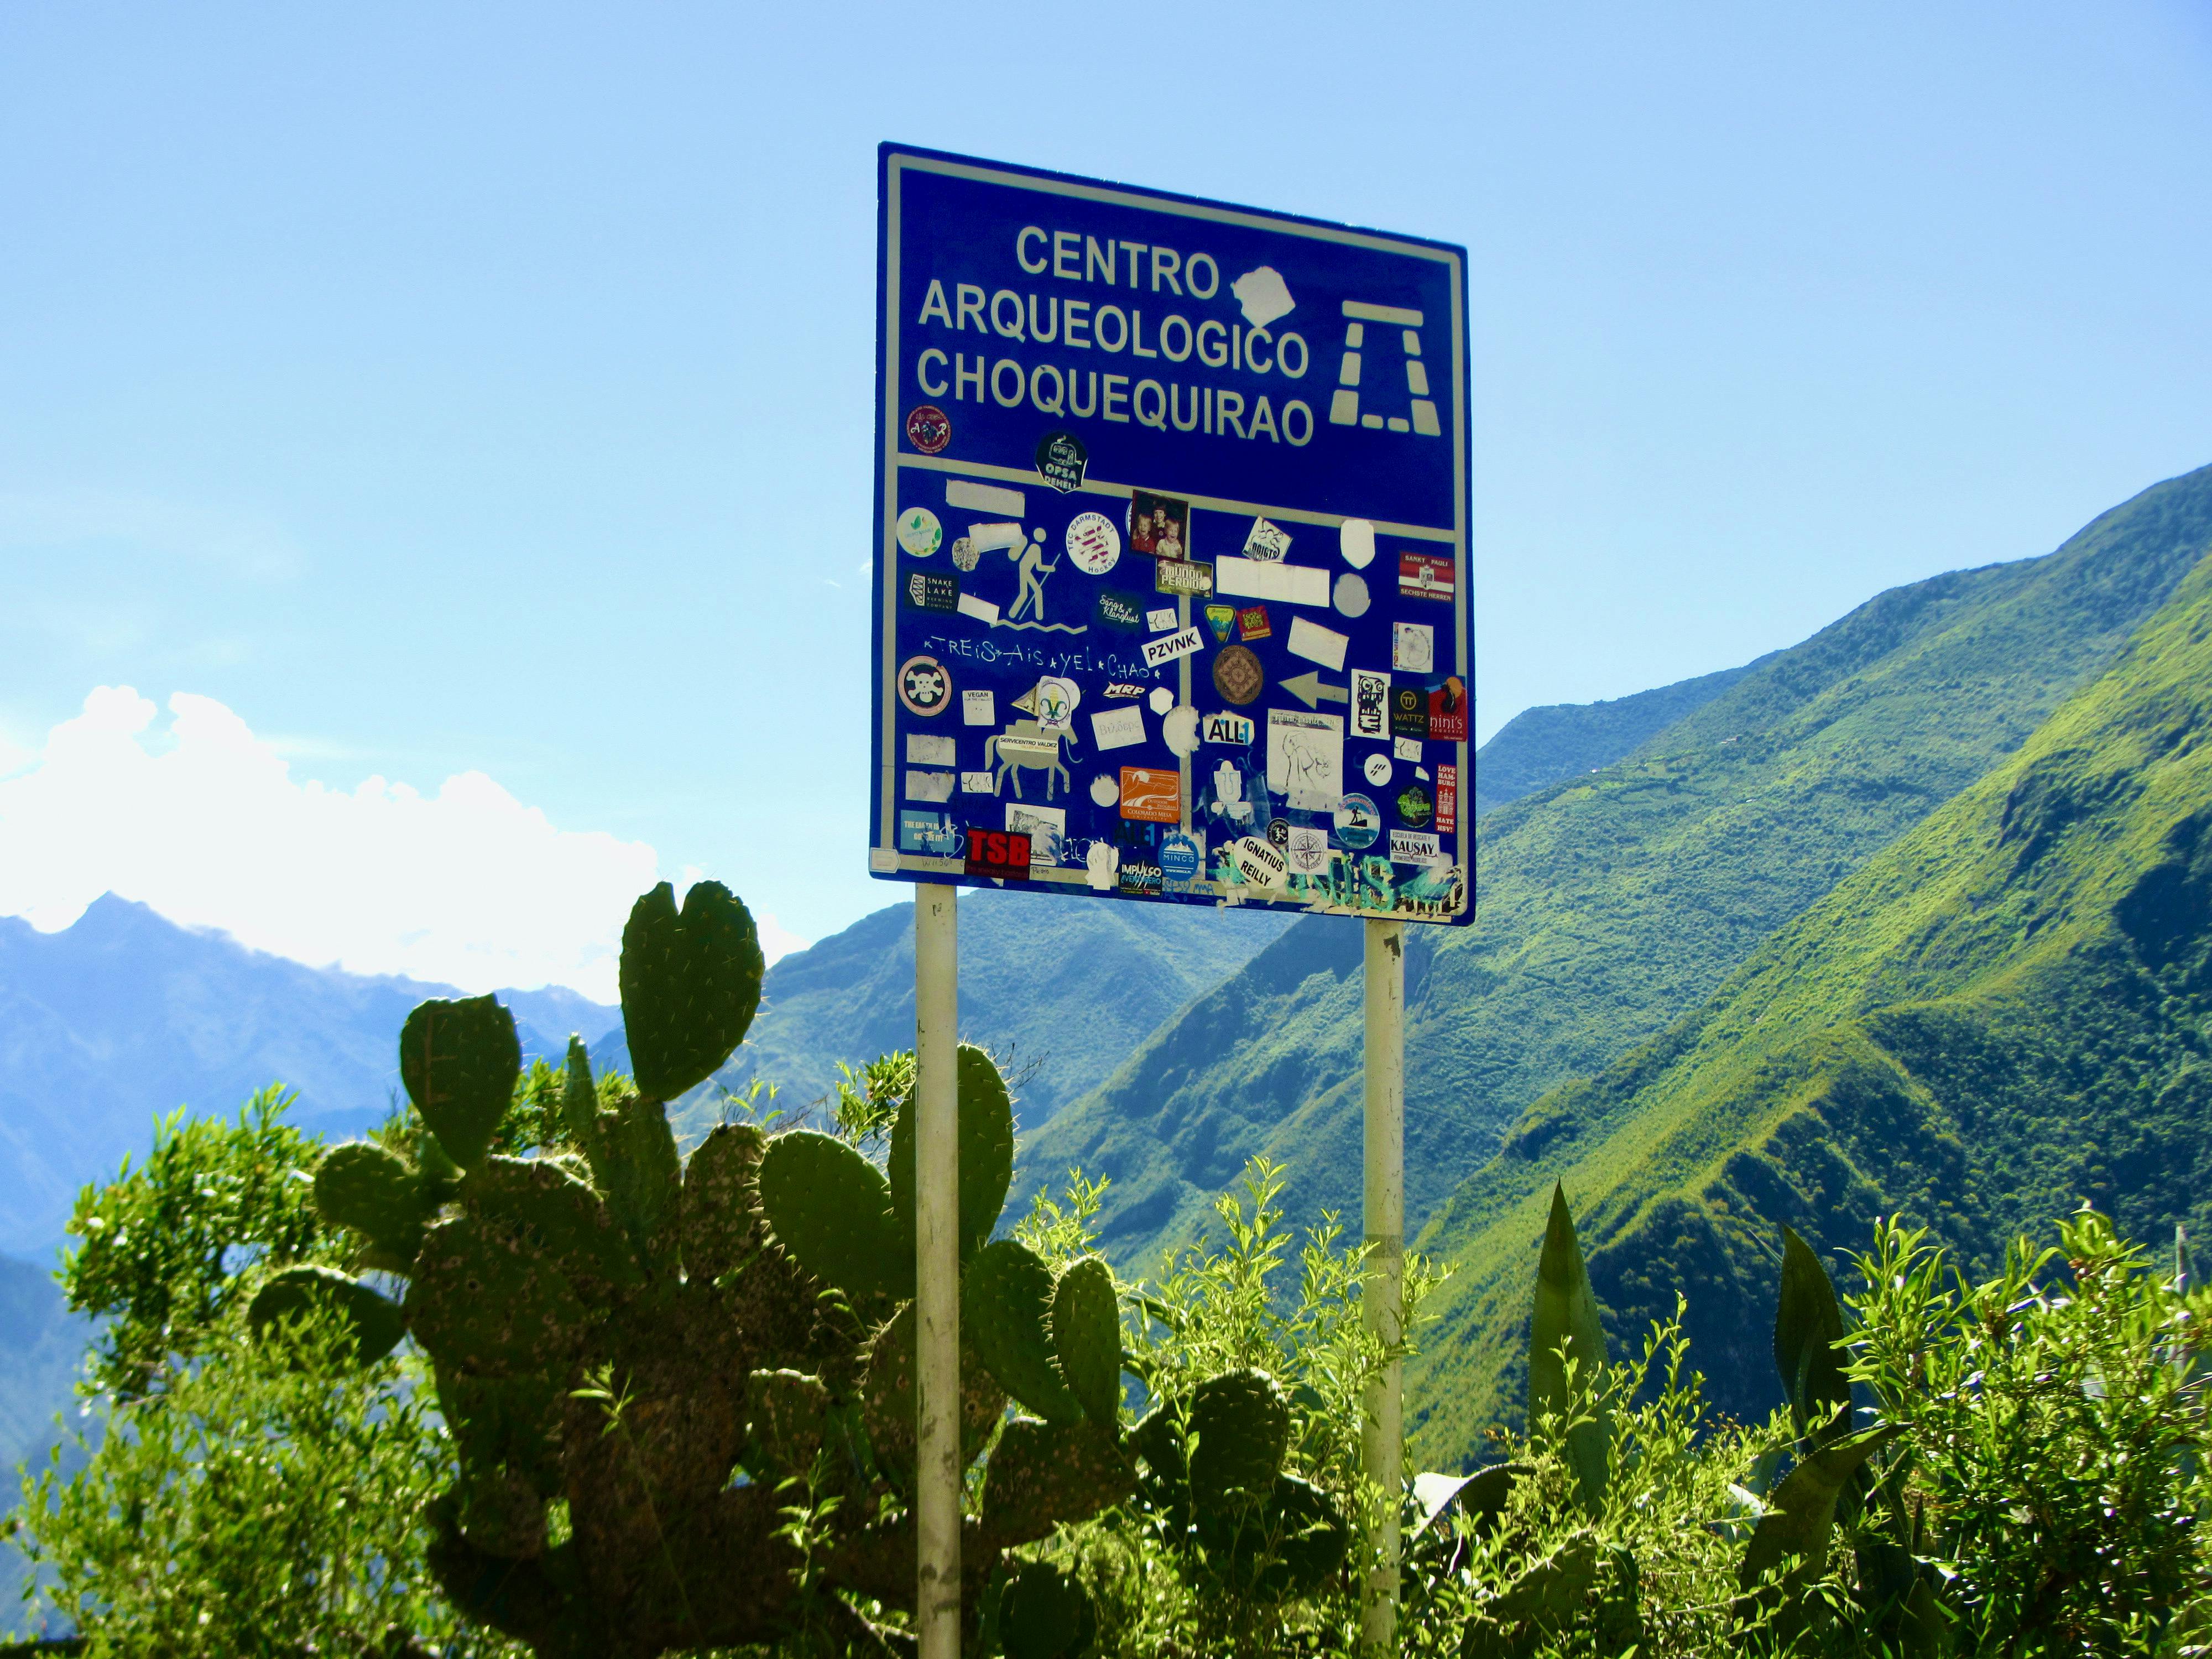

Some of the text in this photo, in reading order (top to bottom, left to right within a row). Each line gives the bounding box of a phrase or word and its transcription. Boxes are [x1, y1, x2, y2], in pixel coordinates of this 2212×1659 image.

[1016, 226, 1219, 300] CENTRO
[918, 279, 1309, 379] ARQUEOLOGICO
[917, 348, 1313, 447] CHOQUEQUIRAO
[1045, 463, 1077, 481] OPSA
[1071, 514, 1114, 533] DARMSTADT
[1088, 557, 1116, 573] Hockey
[927, 578, 952, 588] SNAKE
[1162, 575, 1201, 591] PERDID
[927, 587, 952, 597] LAKE
[1400, 588, 1452, 601] SECHSTE HERREN
[1148, 632, 1197, 661] PZVNK
[1102, 681, 1146, 695] MRP
[1394, 713, 1425, 724] WATTZ
[1430, 714, 1463, 729] nini's
[1000, 737, 1036, 746] SERVICENTRO
[1438, 765, 1455, 774] LOVE
[1438, 772, 1455, 781] HAM-
[1438, 779, 1455, 787] BURG
[1437, 817, 1454, 825] HATE
[1437, 825, 1453, 833] HSV!
[967, 830, 1030, 867] TSB
[1391, 839, 1434, 855] KAUSAY
[1243, 838, 1285, 872] IGNATIUS
[1121, 864, 1162, 878] IMPULSO
[1240, 860, 1271, 887] REILLY
